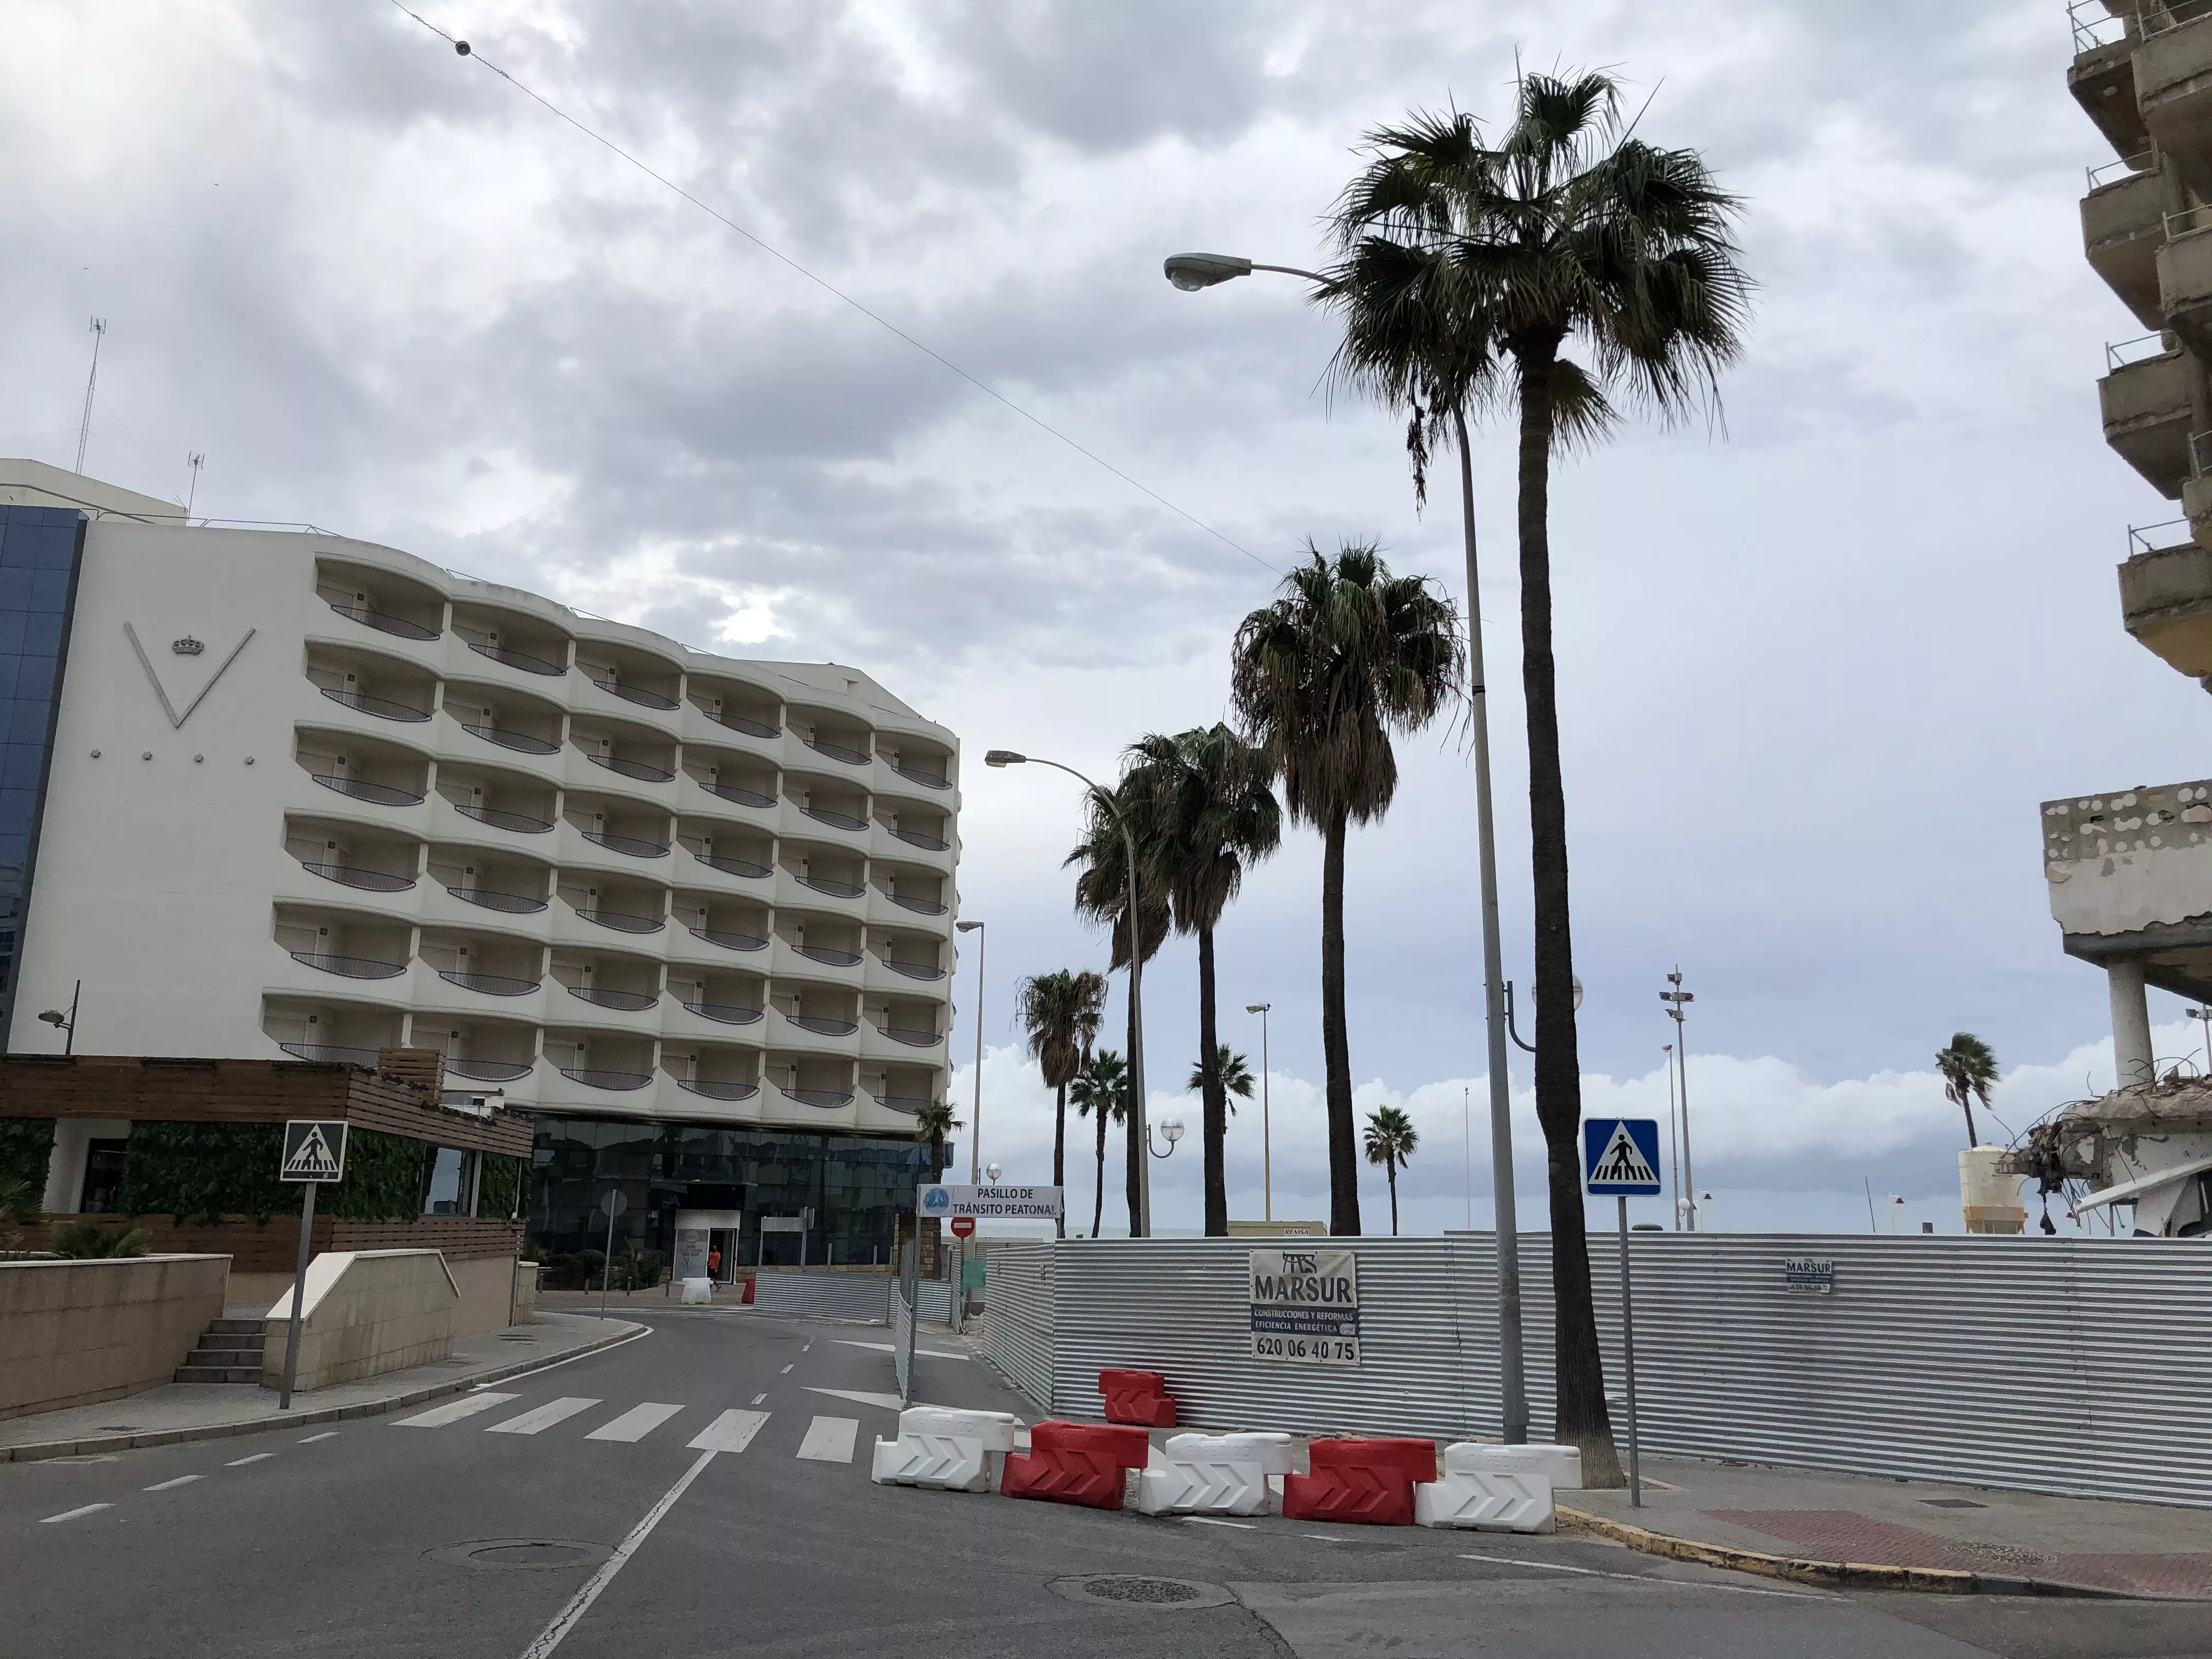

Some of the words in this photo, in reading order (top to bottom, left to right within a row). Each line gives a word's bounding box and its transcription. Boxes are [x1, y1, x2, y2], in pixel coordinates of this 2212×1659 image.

[977, 1188, 1018, 1199] PASILLO
[1020, 1188, 1034, 1199] DE
[953, 1201, 1003, 1215] TRÁNSITO
[1005, 1204, 1057, 1216] PEATONAL
[1786, 1262, 1831, 1273] MARSUR
[1255, 1275, 1352, 1303] MARSUR
[1254, 1309, 1309, 1319] CONSTRUCCIONES
[1310, 1311, 1316, 1319] Y
[1317, 1312, 1353, 1321] REFORMAS
[1255, 1321, 1291, 1330] EFICIENCIA
[1295, 1322, 1338, 1332] ENERGÉTICA
[1257, 1337, 1283, 1356] 620
[1288, 1339, 1306, 1357] 06
[1311, 1341, 1329, 1359] 40
[1334, 1342, 1355, 1361] 75
